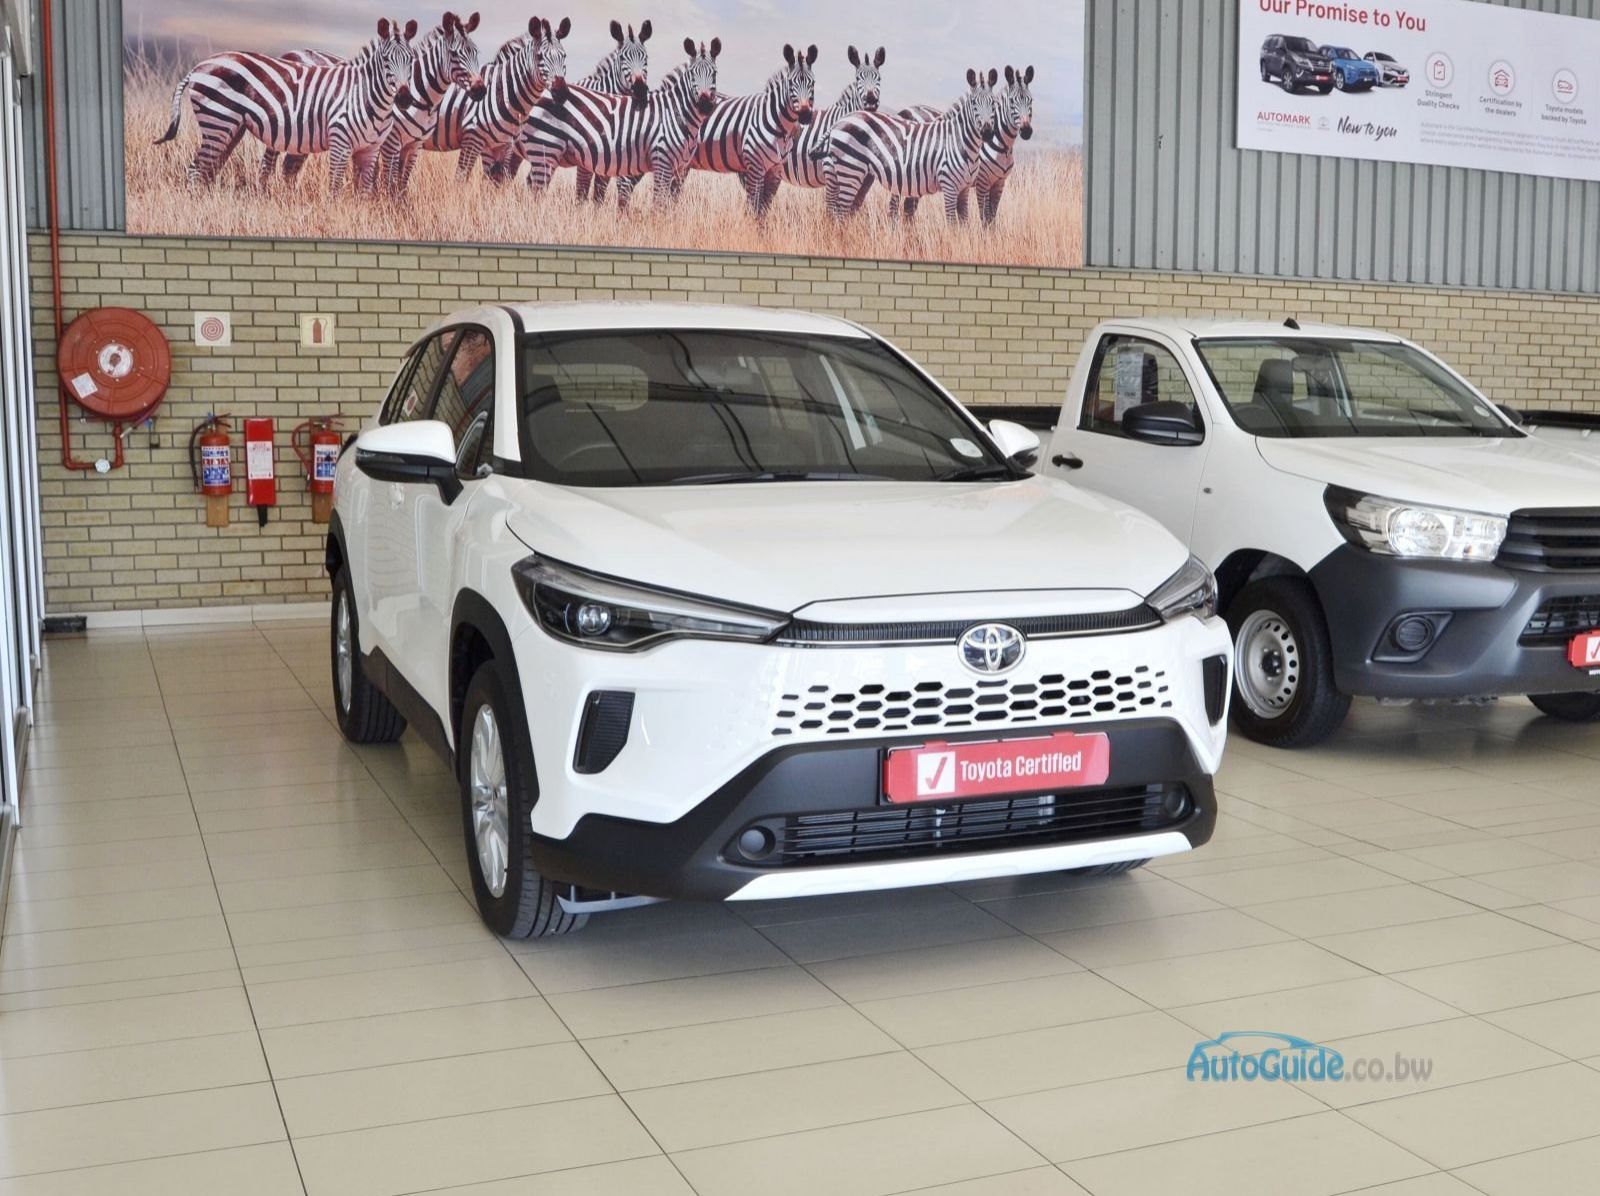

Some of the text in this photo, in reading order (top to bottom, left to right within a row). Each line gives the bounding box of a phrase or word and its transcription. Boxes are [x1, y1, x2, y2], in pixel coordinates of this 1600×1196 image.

[1259, 0, 1426, 32] Our Promise to You
[1417, 98, 1460, 110] Quality Checks
[1479, 96, 1523, 109] Certification by
[1545, 103, 1563, 113] Toyota
[1257, 111, 1312, 125] AUTOMARK
[1337, 115, 1398, 142] New to you
[960, 751, 1082, 782] Toyota Certified
